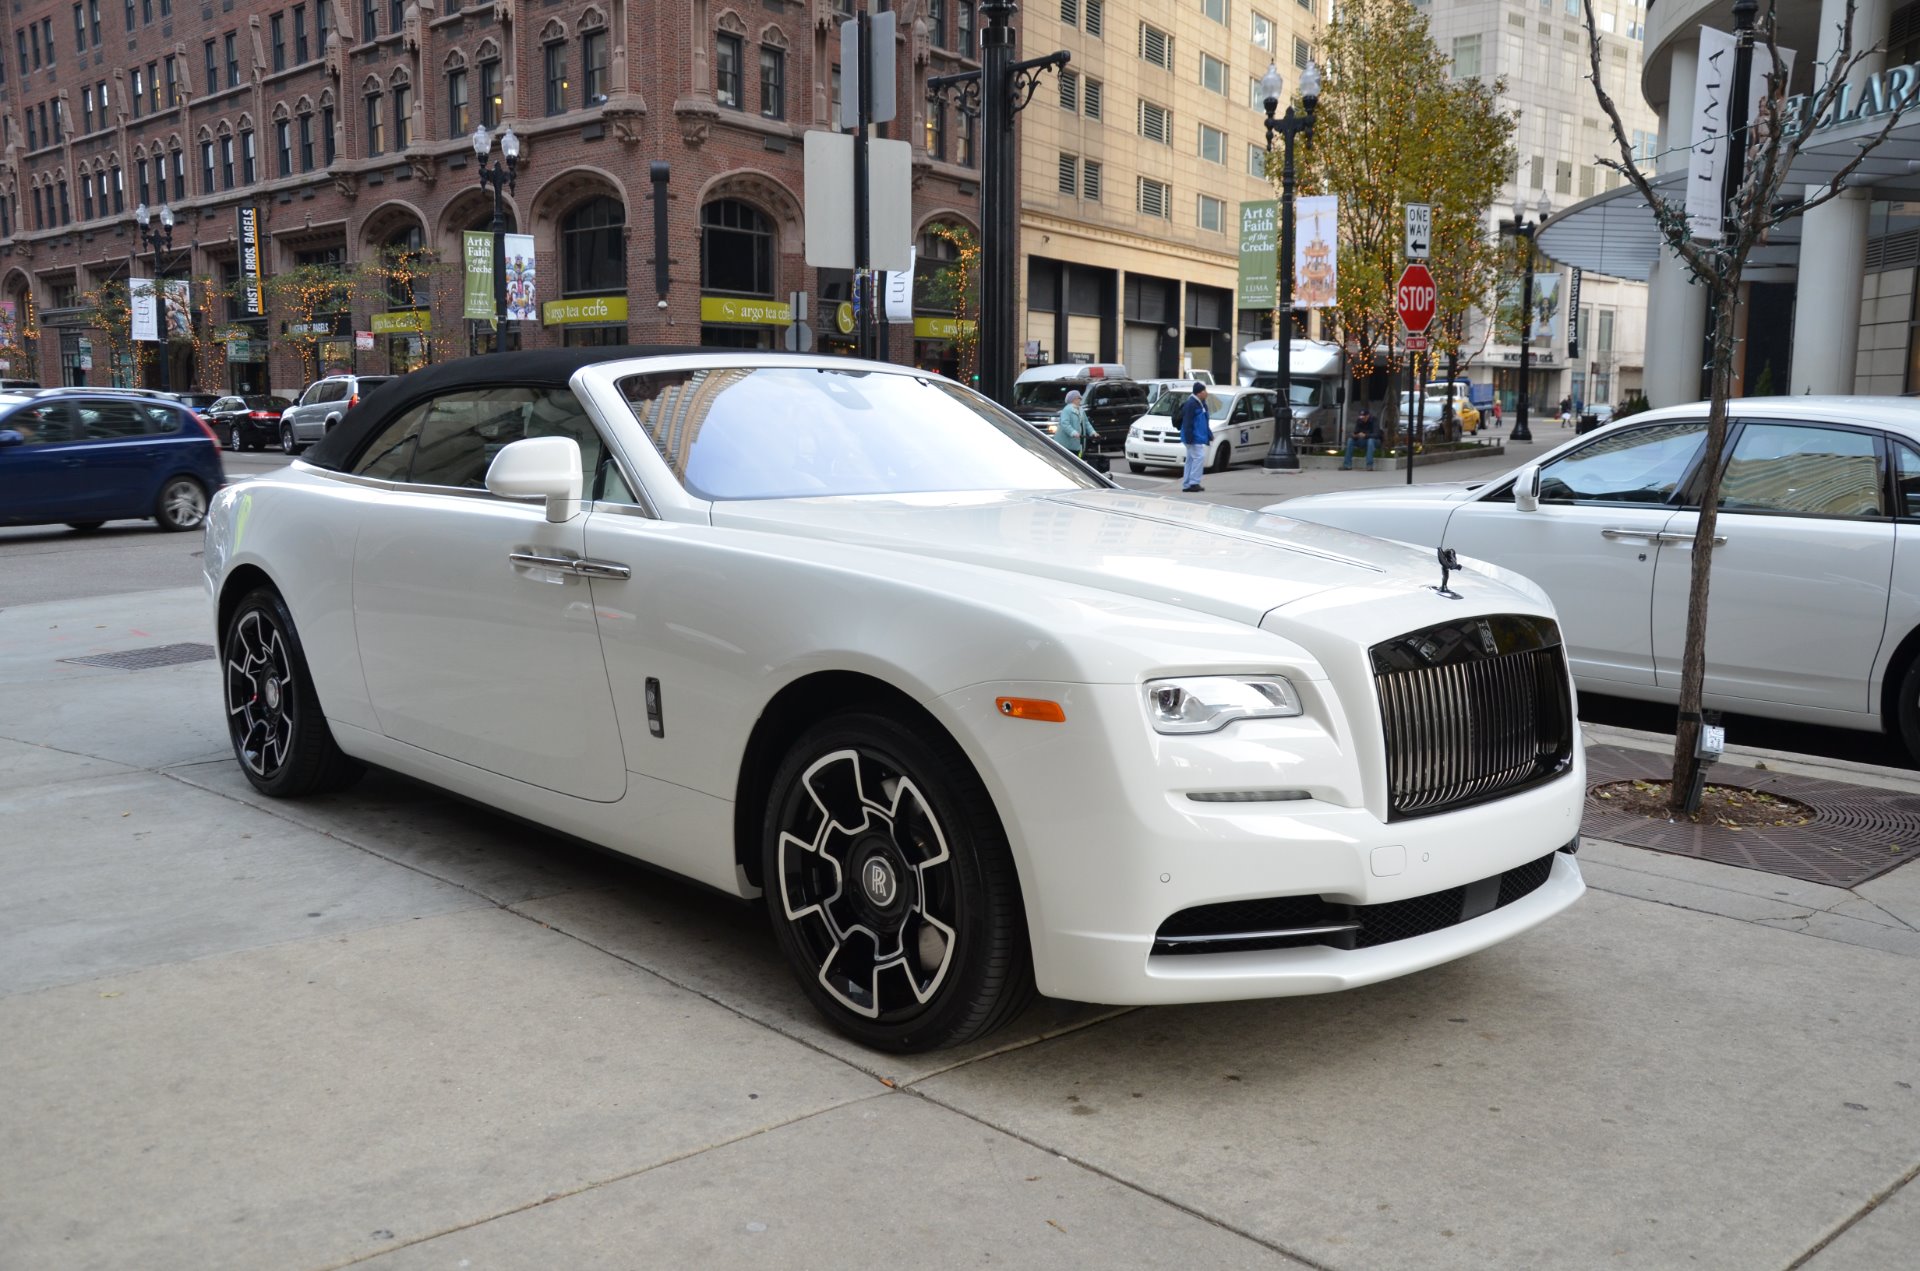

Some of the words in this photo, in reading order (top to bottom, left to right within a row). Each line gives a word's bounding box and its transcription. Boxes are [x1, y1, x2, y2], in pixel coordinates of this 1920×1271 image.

[1811, 62, 1920, 130] CLAR
[1698, 48, 1724, 181] LUMA
[1243, 207, 1263, 219] Art
[1265, 207, 1275, 218] &
[1409, 209, 1428, 222] ONE
[242, 209, 256, 244] BAGELS
[1243, 219, 1273, 232] Faith
[1409, 224, 1428, 237] WAY
[467, 236, 483, 247] Art
[484, 239, 491, 247] &
[1248, 233, 1257, 243] of
[1257, 233, 1268, 241] the
[468, 246, 491, 257] Faith
[1241, 241, 1275, 252] Creche
[244, 247, 257, 271] BROS.
[467, 264, 492, 274] Creche
[246, 272, 259, 313] EINSTN
[1400, 286, 1434, 312] STOP
[566, 305, 579, 318] tea
[582, 298, 609, 317] café
[741, 306, 764, 322] argo
[765, 306, 777, 320] tea
[1567, 321, 1578, 344] rack
[1406, 339, 1416, 349] ALL
[1416, 339, 1426, 348] WAY
[871, 864, 887, 897] RR
